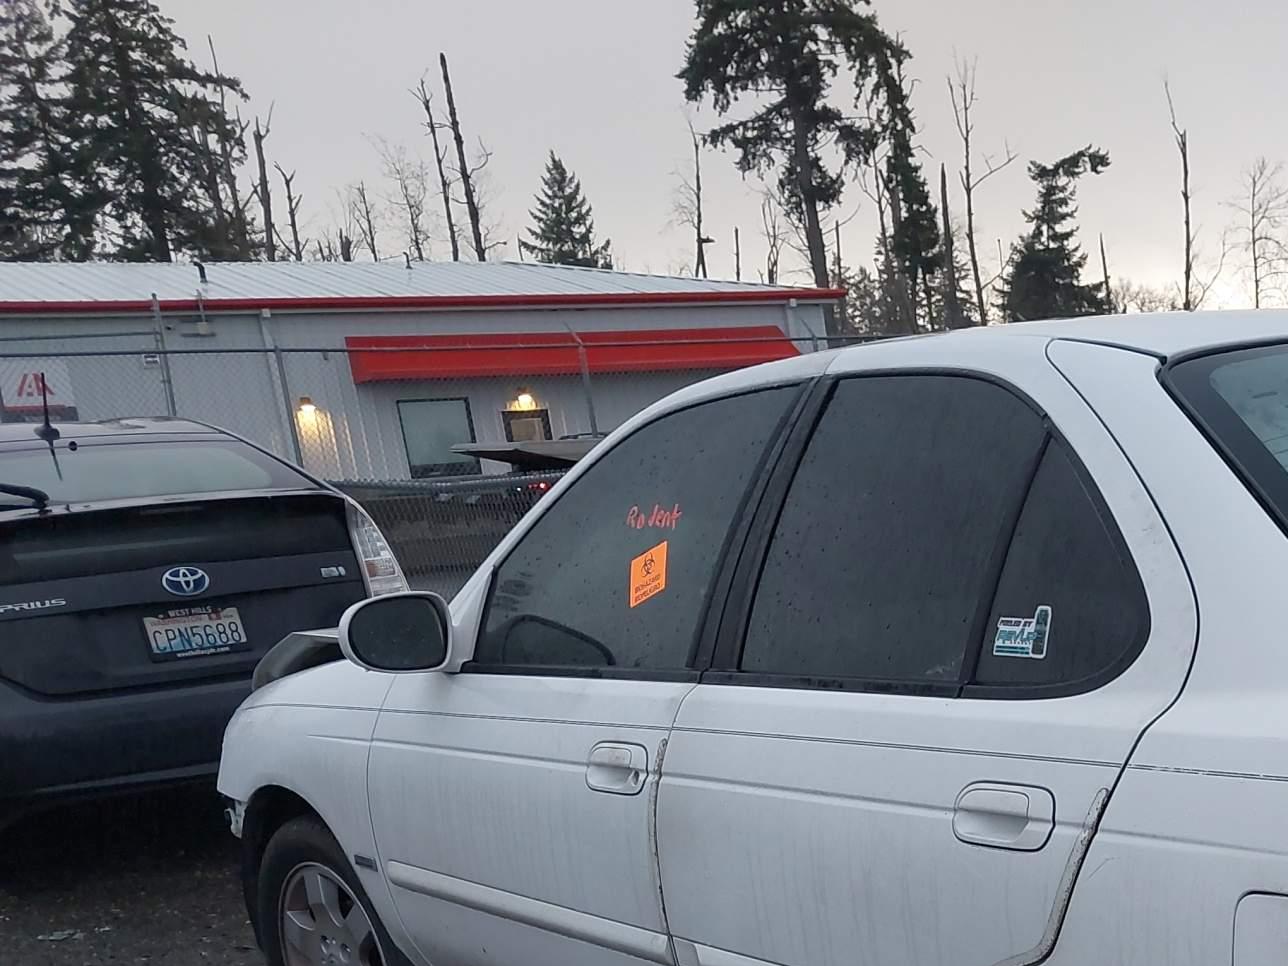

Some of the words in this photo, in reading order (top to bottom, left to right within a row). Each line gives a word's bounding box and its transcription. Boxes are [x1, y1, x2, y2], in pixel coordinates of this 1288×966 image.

[168, 609, 189, 617] WEST
[191, 606, 212, 615] HILLS
[152, 621, 241, 652] CPN5688
